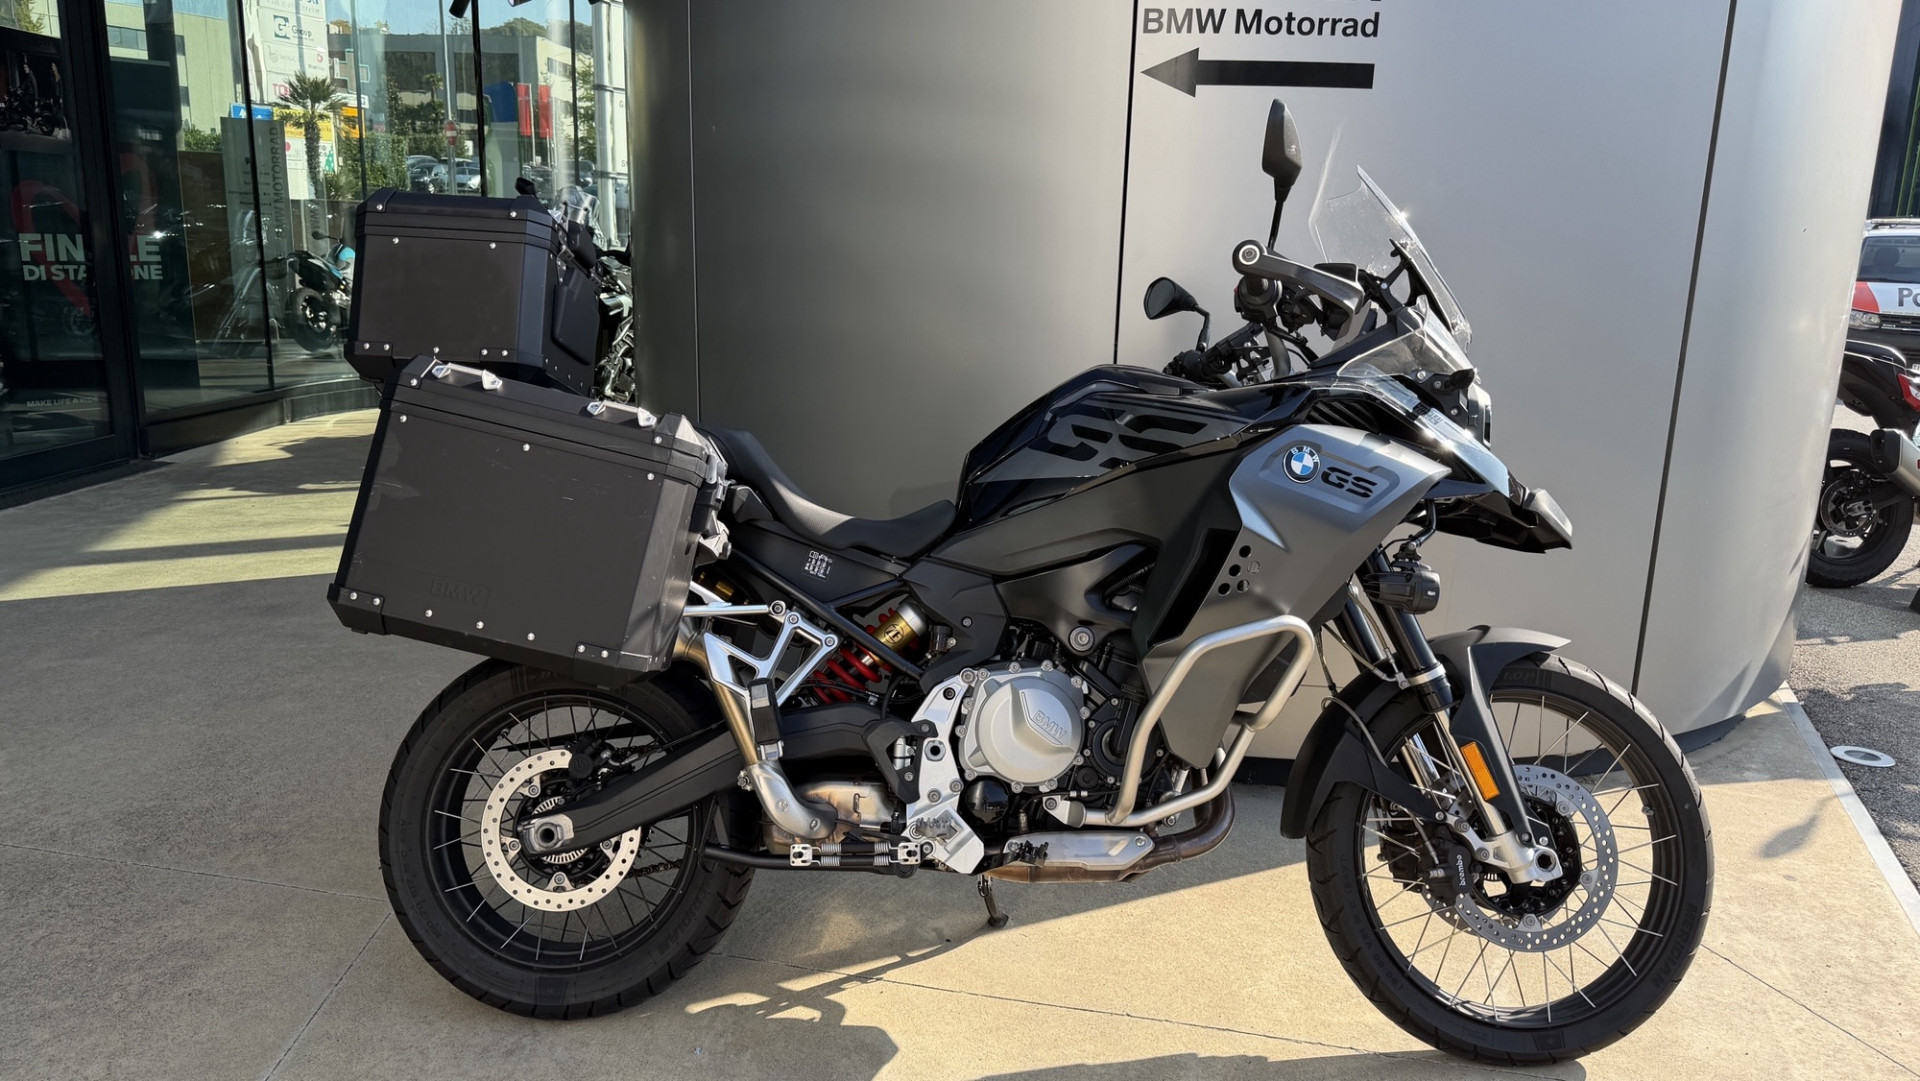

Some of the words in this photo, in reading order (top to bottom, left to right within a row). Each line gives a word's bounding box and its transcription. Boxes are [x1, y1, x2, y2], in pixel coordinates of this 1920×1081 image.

[1142, 8, 1227, 34] BMW
[1234, 9, 1380, 38] Motorrad
[269, 126, 284, 203] MOTORRAD
[23, 264, 47, 281] DI
[26, 400, 52, 408] MAKE
[1290, 445, 1320, 463] BMW
[1321, 466, 1378, 498] GS
[432, 580, 484, 607] BMW
[1033, 709, 1068, 739] BMW
[1456, 854, 1467, 886] brembo
